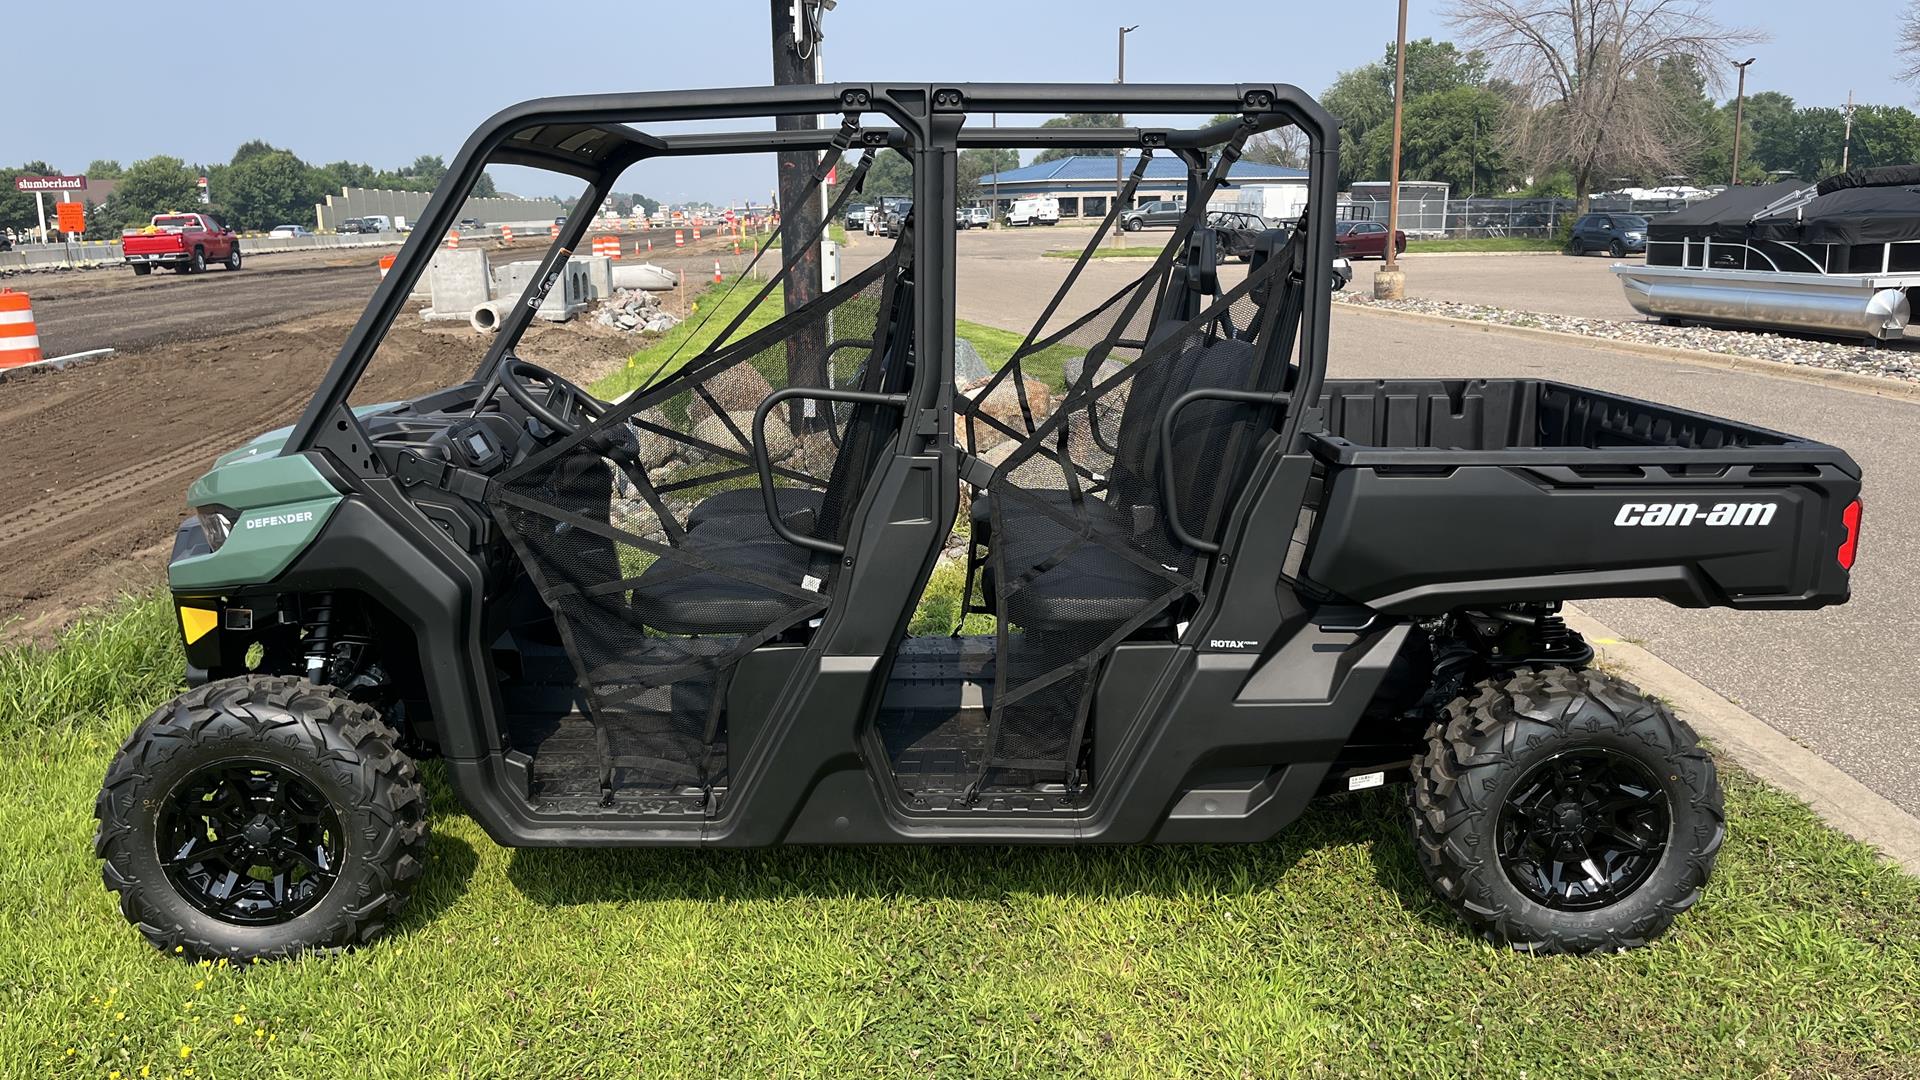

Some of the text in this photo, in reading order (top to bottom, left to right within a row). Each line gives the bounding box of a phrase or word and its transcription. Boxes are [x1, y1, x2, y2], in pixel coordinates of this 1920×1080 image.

[18, 178, 81, 189] slumberland
[246, 511, 313, 529] DEFENDER
[1613, 503, 1778, 526] can-am
[1210, 639, 1244, 648] ROTAX
